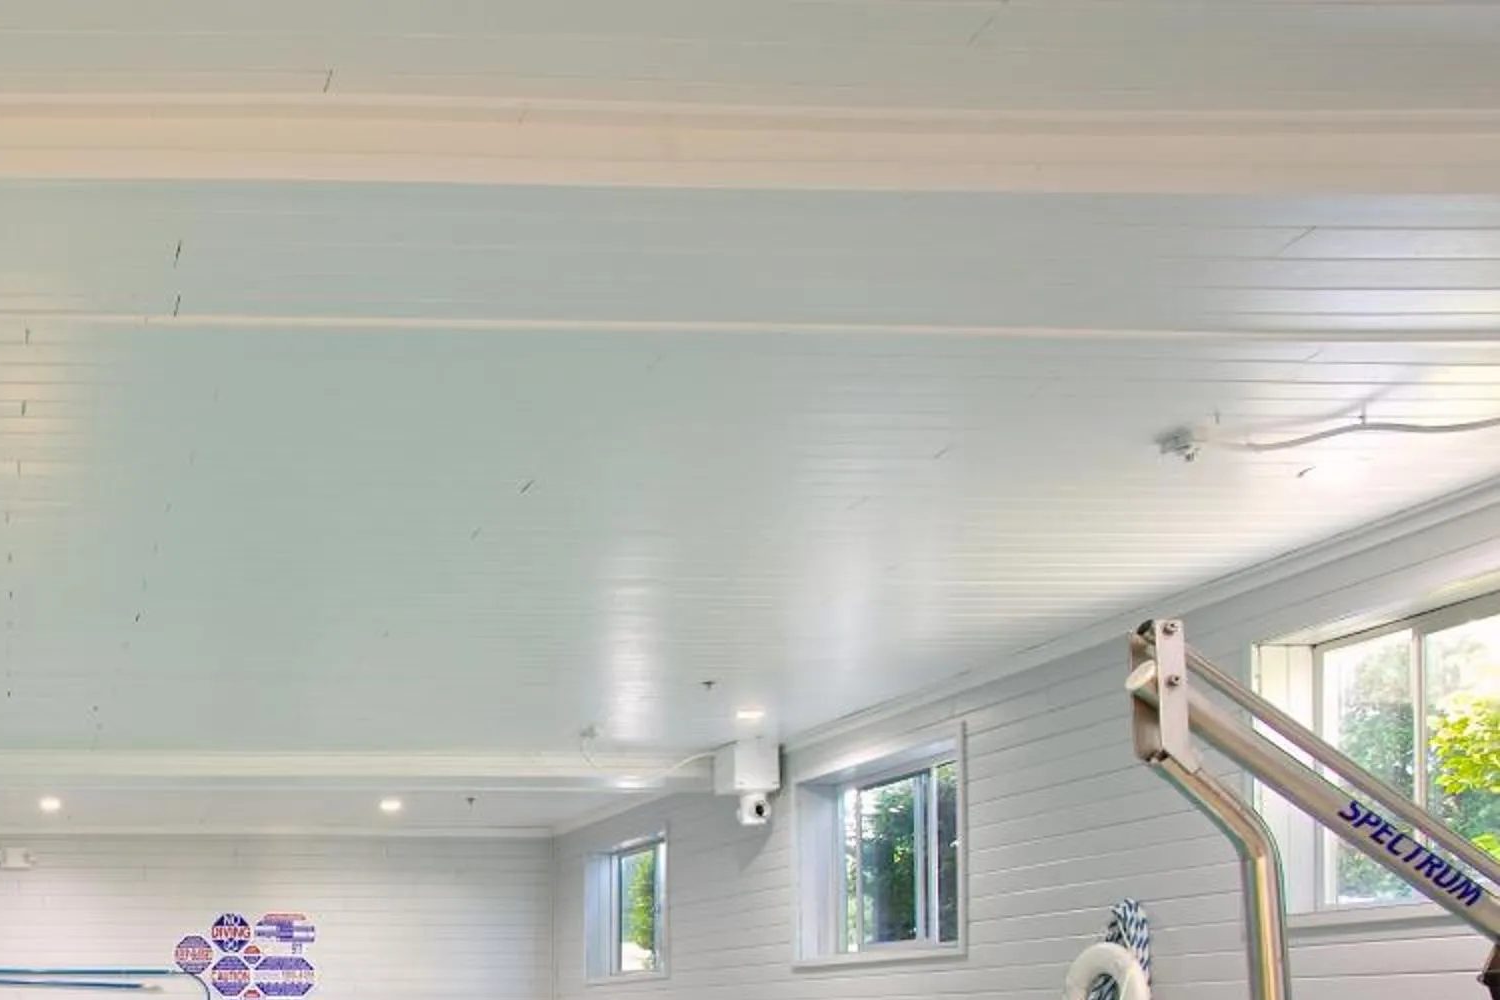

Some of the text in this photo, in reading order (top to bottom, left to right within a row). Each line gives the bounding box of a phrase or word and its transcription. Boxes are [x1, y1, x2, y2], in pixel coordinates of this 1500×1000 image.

[1338, 799, 1482, 906] SPECTRUM
[223, 913, 240, 926] NO
[211, 926, 251, 939] DIVING
